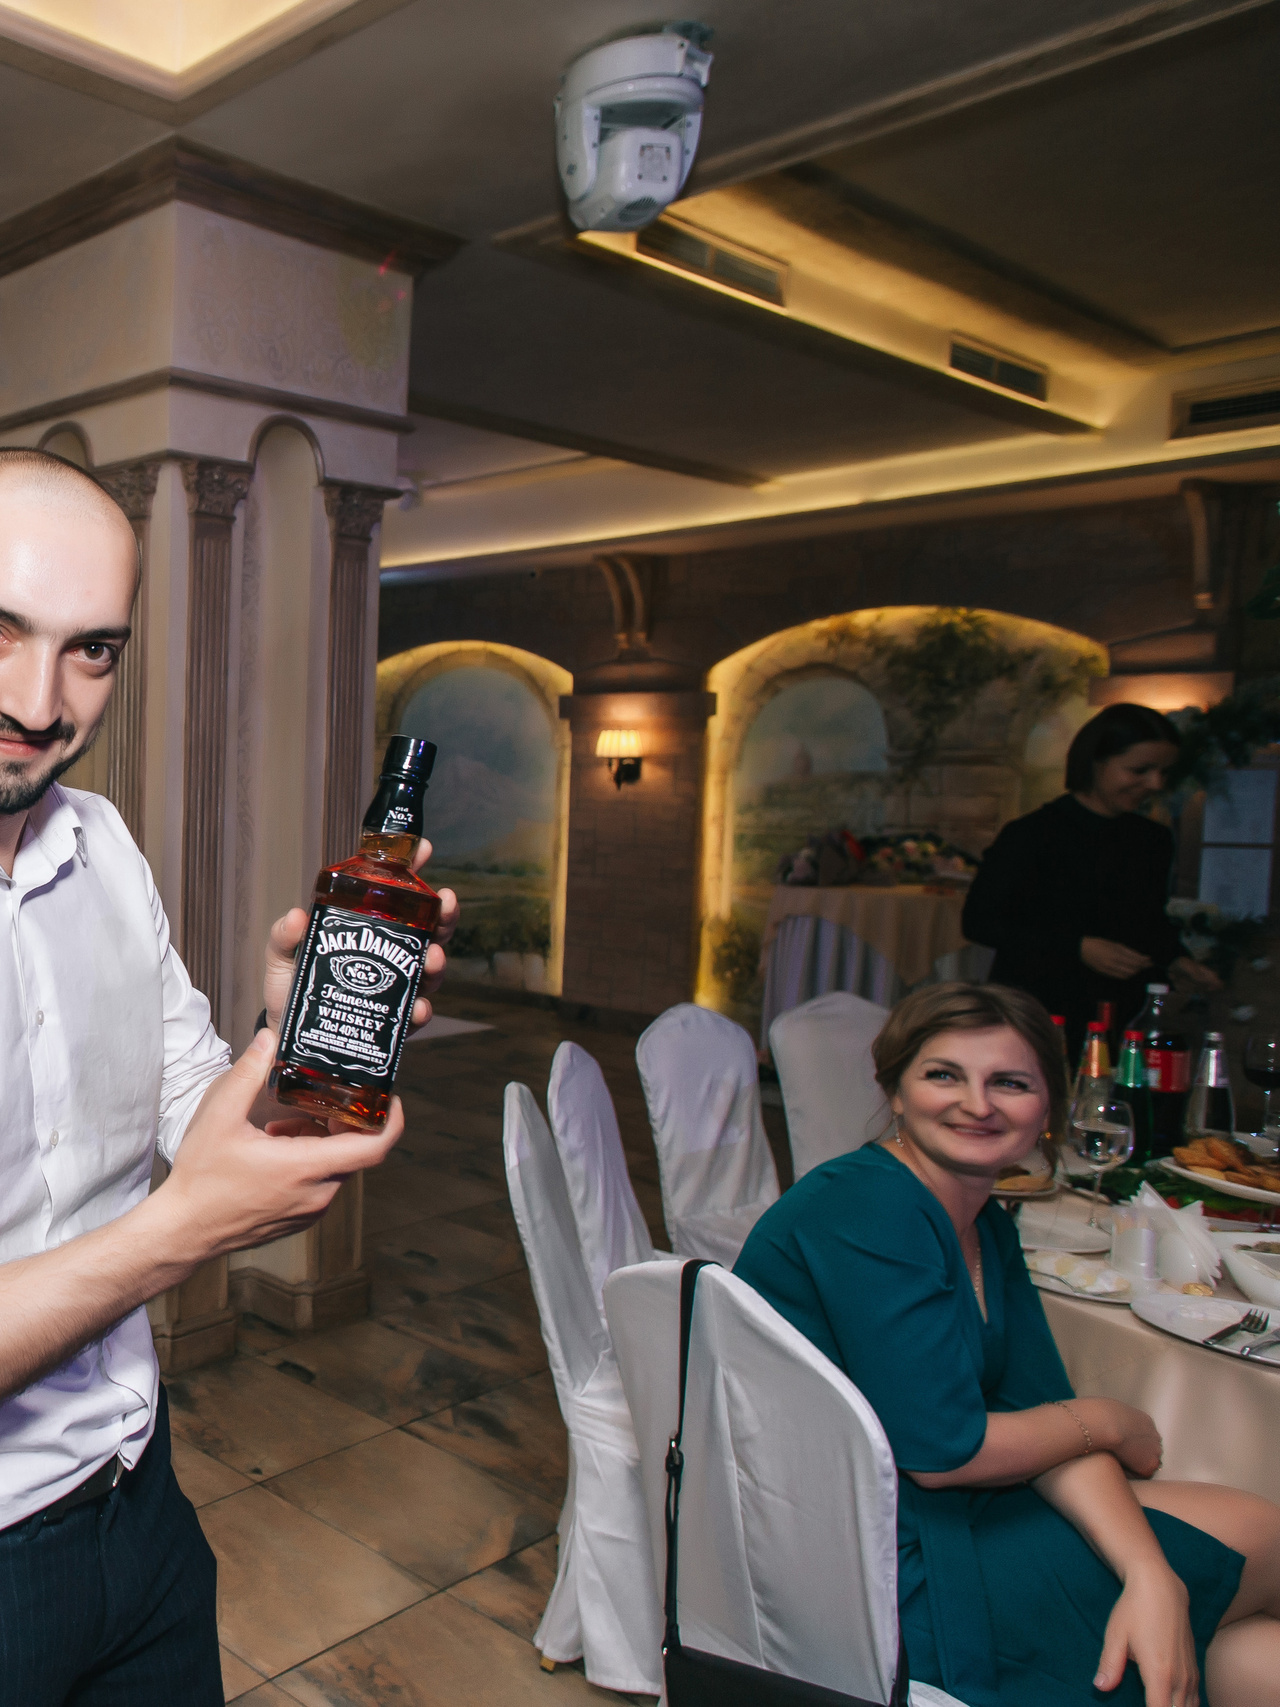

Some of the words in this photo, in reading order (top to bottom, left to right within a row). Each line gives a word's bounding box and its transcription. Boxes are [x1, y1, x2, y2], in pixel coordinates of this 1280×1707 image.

[387, 809, 414, 822] No.7
[316, 930, 359, 955] JACK
[359, 927, 420, 977] DANIEL'S
[354, 962, 372, 971] Old
[320, 983, 390, 1014] Tennessee
[318, 1005, 385, 1031] WHISKEY
[335, 1003, 352, 1012] SOUR
[353, 1007, 372, 1017] MASH
[300, 1030, 319, 1041] JACK
[320, 1034, 346, 1048] DANIEL
[319, 1018, 339, 1033] 70cl
[339, 1024, 360, 1039] 40%
[360, 1028, 376, 1043] Vol.
